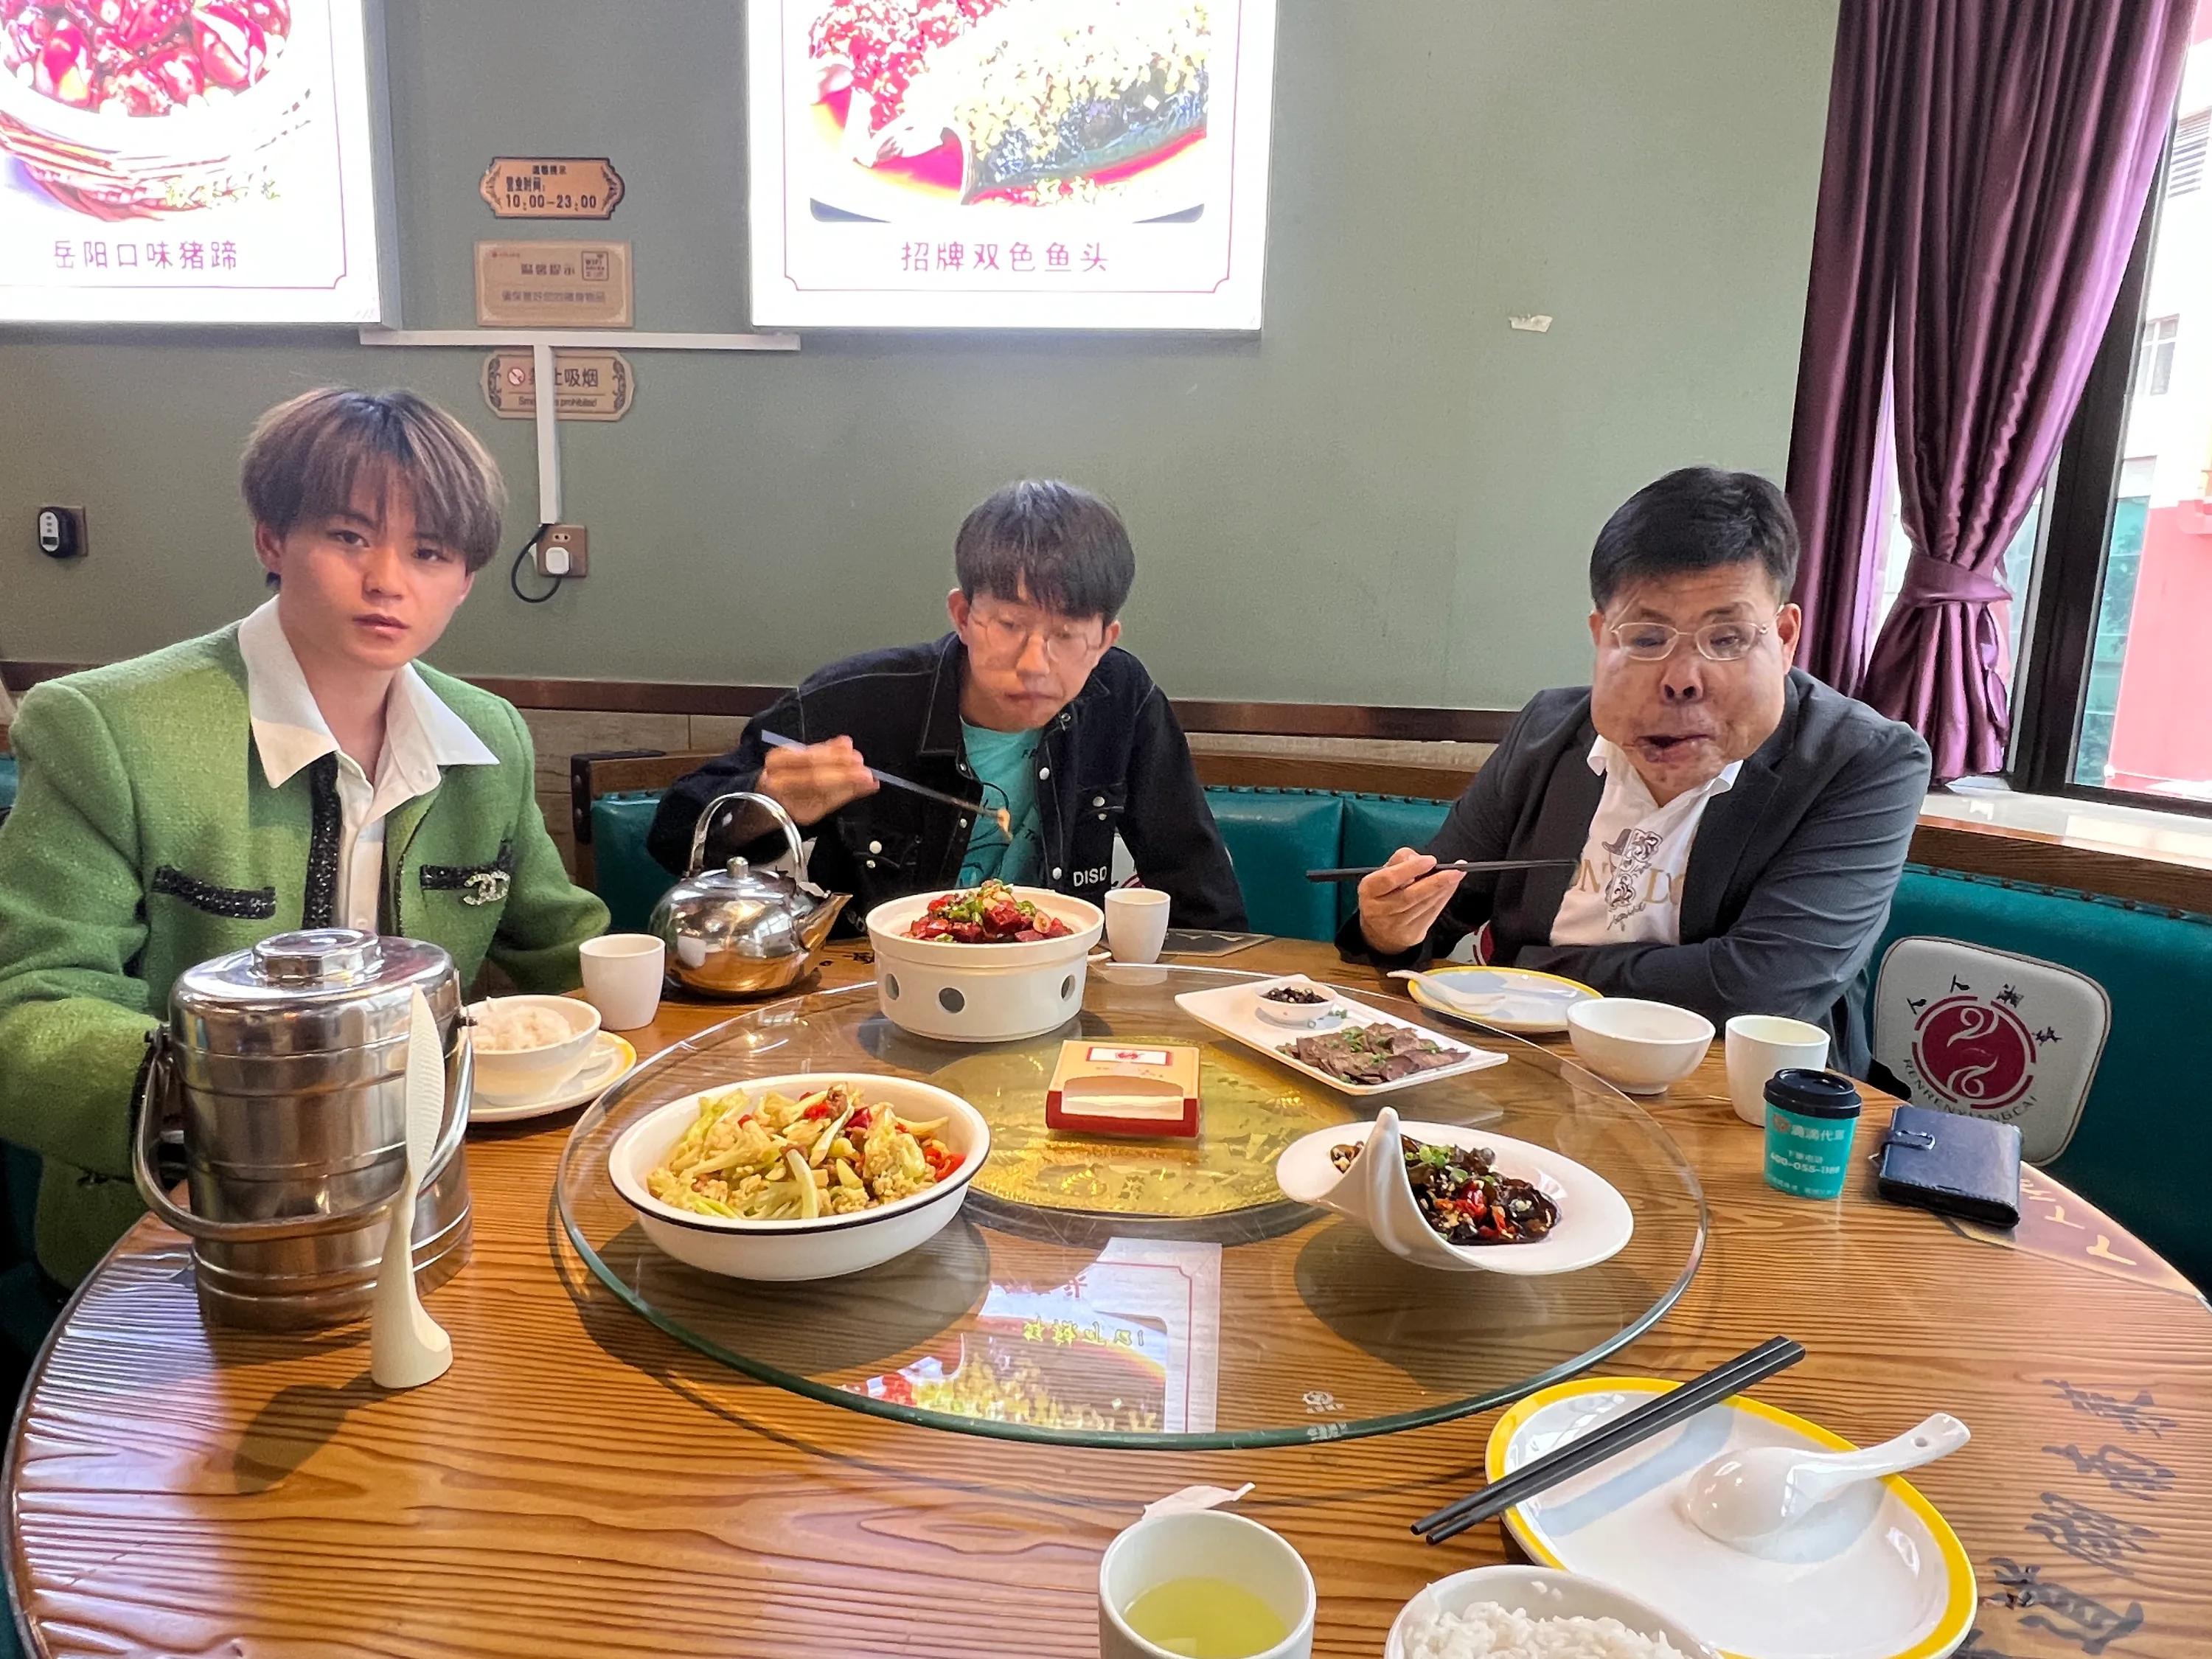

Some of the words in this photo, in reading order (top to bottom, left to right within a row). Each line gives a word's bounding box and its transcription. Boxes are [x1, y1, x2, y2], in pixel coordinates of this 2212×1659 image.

[54, 240, 238, 271] 岳阳口味猪蹄
[901, 241, 1108, 272] 招牌双色鱼头
[560, 397, 597, 407] prohibited
[1958, 1379, 2179, 1659] 道湖南菜
